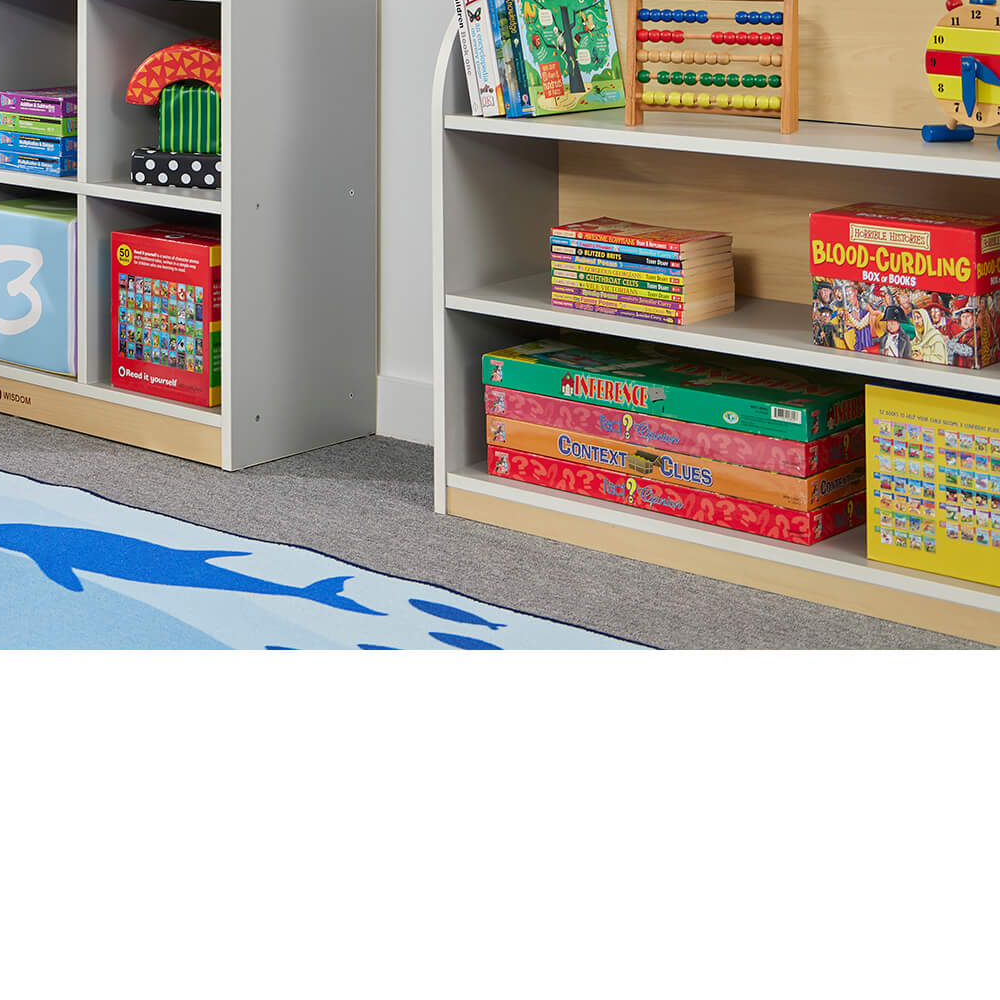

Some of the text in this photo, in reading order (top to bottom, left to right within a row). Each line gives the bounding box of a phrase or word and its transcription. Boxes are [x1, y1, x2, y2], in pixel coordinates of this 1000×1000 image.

[971, 10, 982, 19] 12
[951, 17, 960, 26] 11
[933, 35, 944, 44] 10
[930, 58, 936, 67] 9
[938, 83, 944, 92] 8
[954, 103, 960, 112] 7
[976, 112, 982, 121] 6
[853, 228, 926, 245] HORRIBLE HISTORIES
[119, 248, 130, 258] 50
[584, 249, 622, 260] BLITZED BRITS
[812, 239, 971, 282] BLOOD-CURDLING
[586, 274, 620, 284] CUT-THROAT
[862, 270, 881, 282] BOX
[889, 275, 917, 286] BOOKS
[126, 368, 177, 387] Read it yourself
[574, 373, 649, 409] INFERENCE
[3, 391, 32, 405] WISDOM
[558, 434, 713, 488] CONTEXT CLUES
